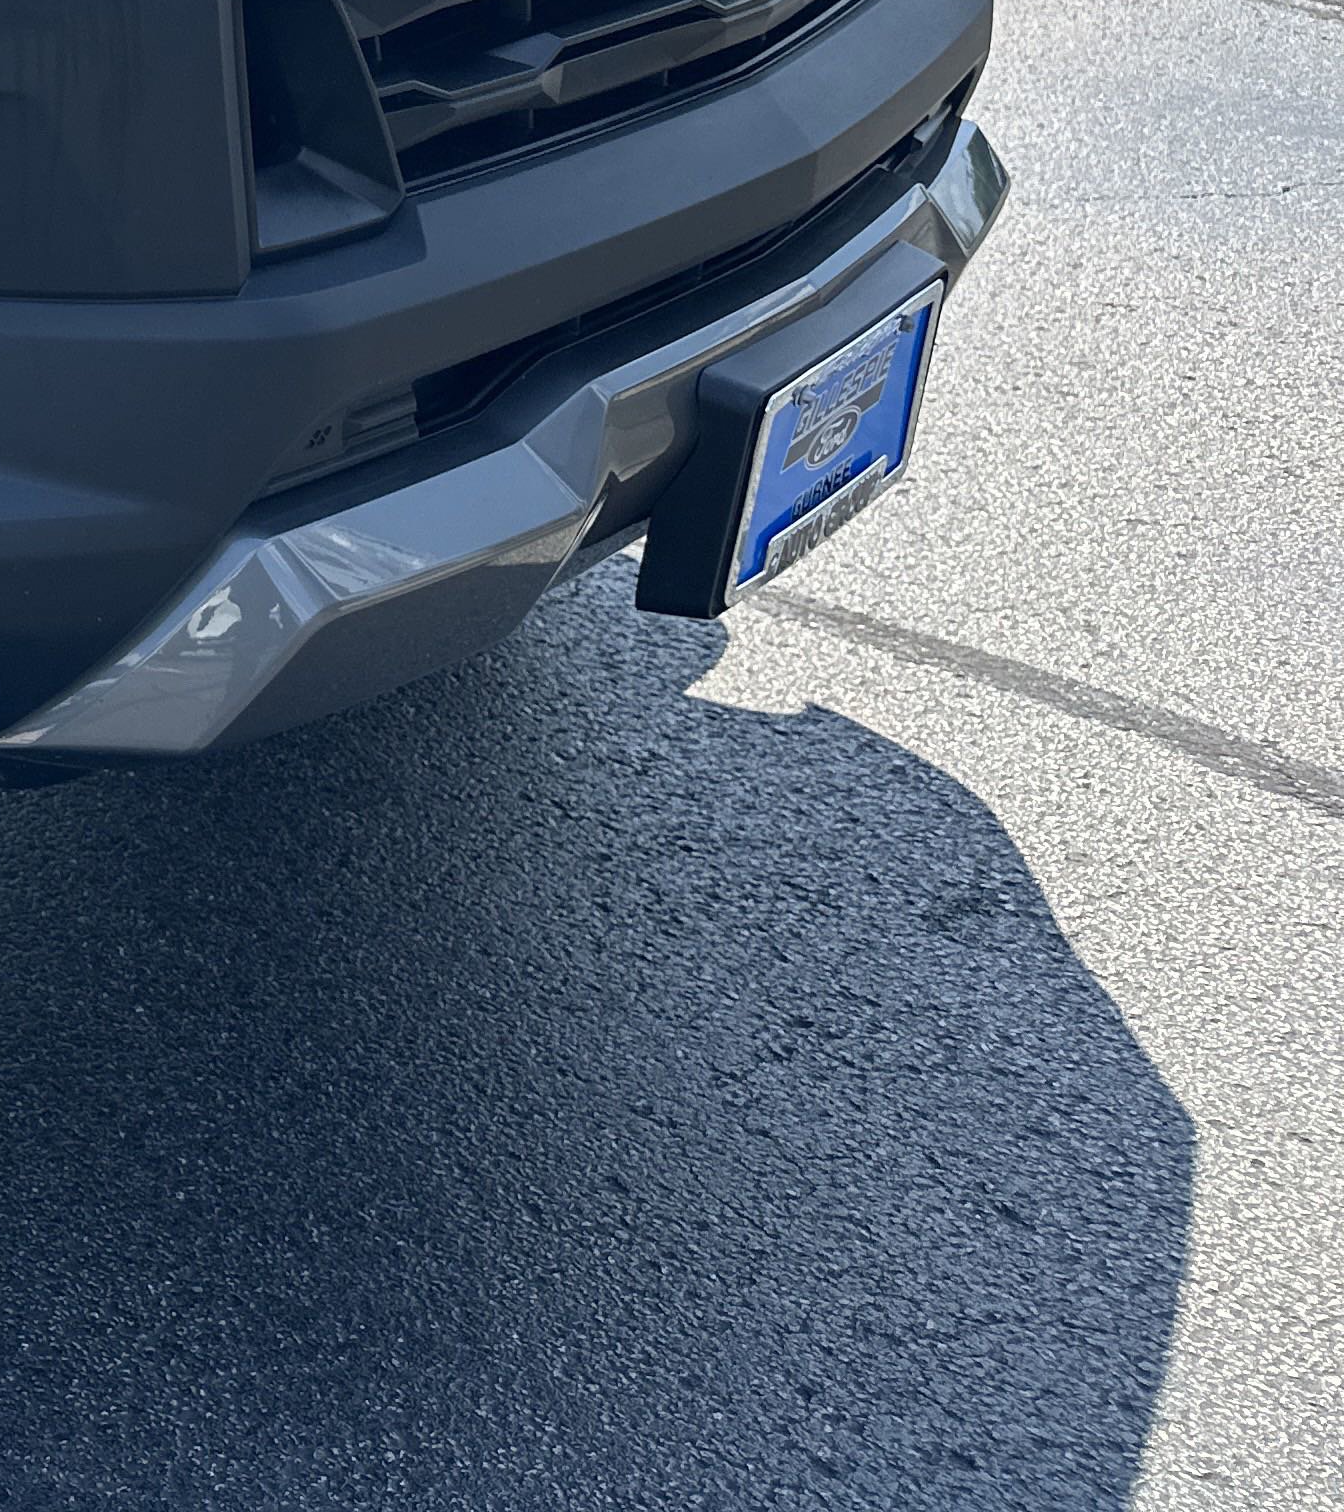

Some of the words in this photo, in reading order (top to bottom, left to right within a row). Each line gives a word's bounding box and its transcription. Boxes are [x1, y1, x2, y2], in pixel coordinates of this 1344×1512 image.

[792, 339, 899, 440] GILLESPIE
[813, 417, 852, 463] Ford
[791, 454, 855, 522] GURNEE
